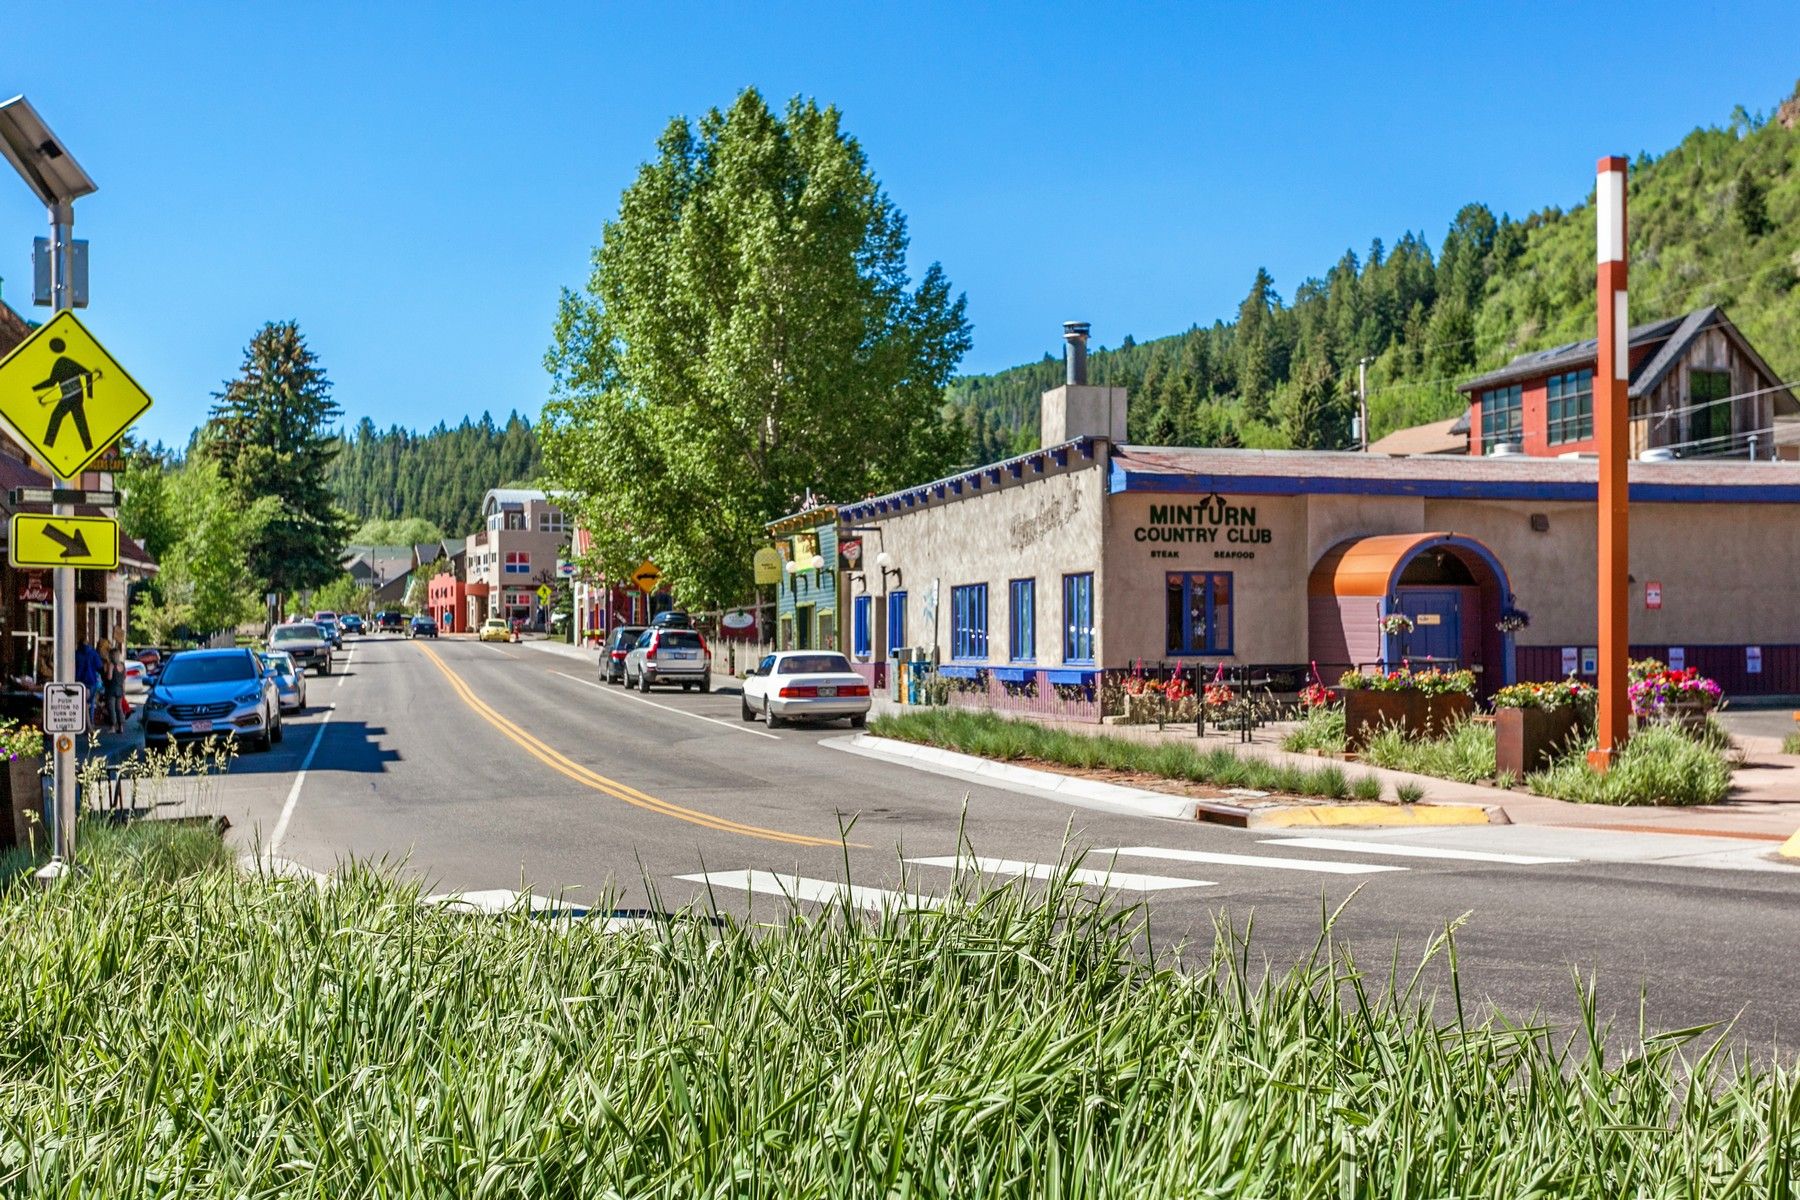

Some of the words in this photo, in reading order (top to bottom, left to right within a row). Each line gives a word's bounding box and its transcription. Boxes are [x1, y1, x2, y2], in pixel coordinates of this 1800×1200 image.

[1150, 505, 1256, 526] MINTURN
[1134, 527, 1218, 543] COUNTRY
[1226, 528, 1272, 544] CLUB
[1150, 550, 1180, 559] STEAK
[1213, 551, 1255, 559] SEAFOOD
